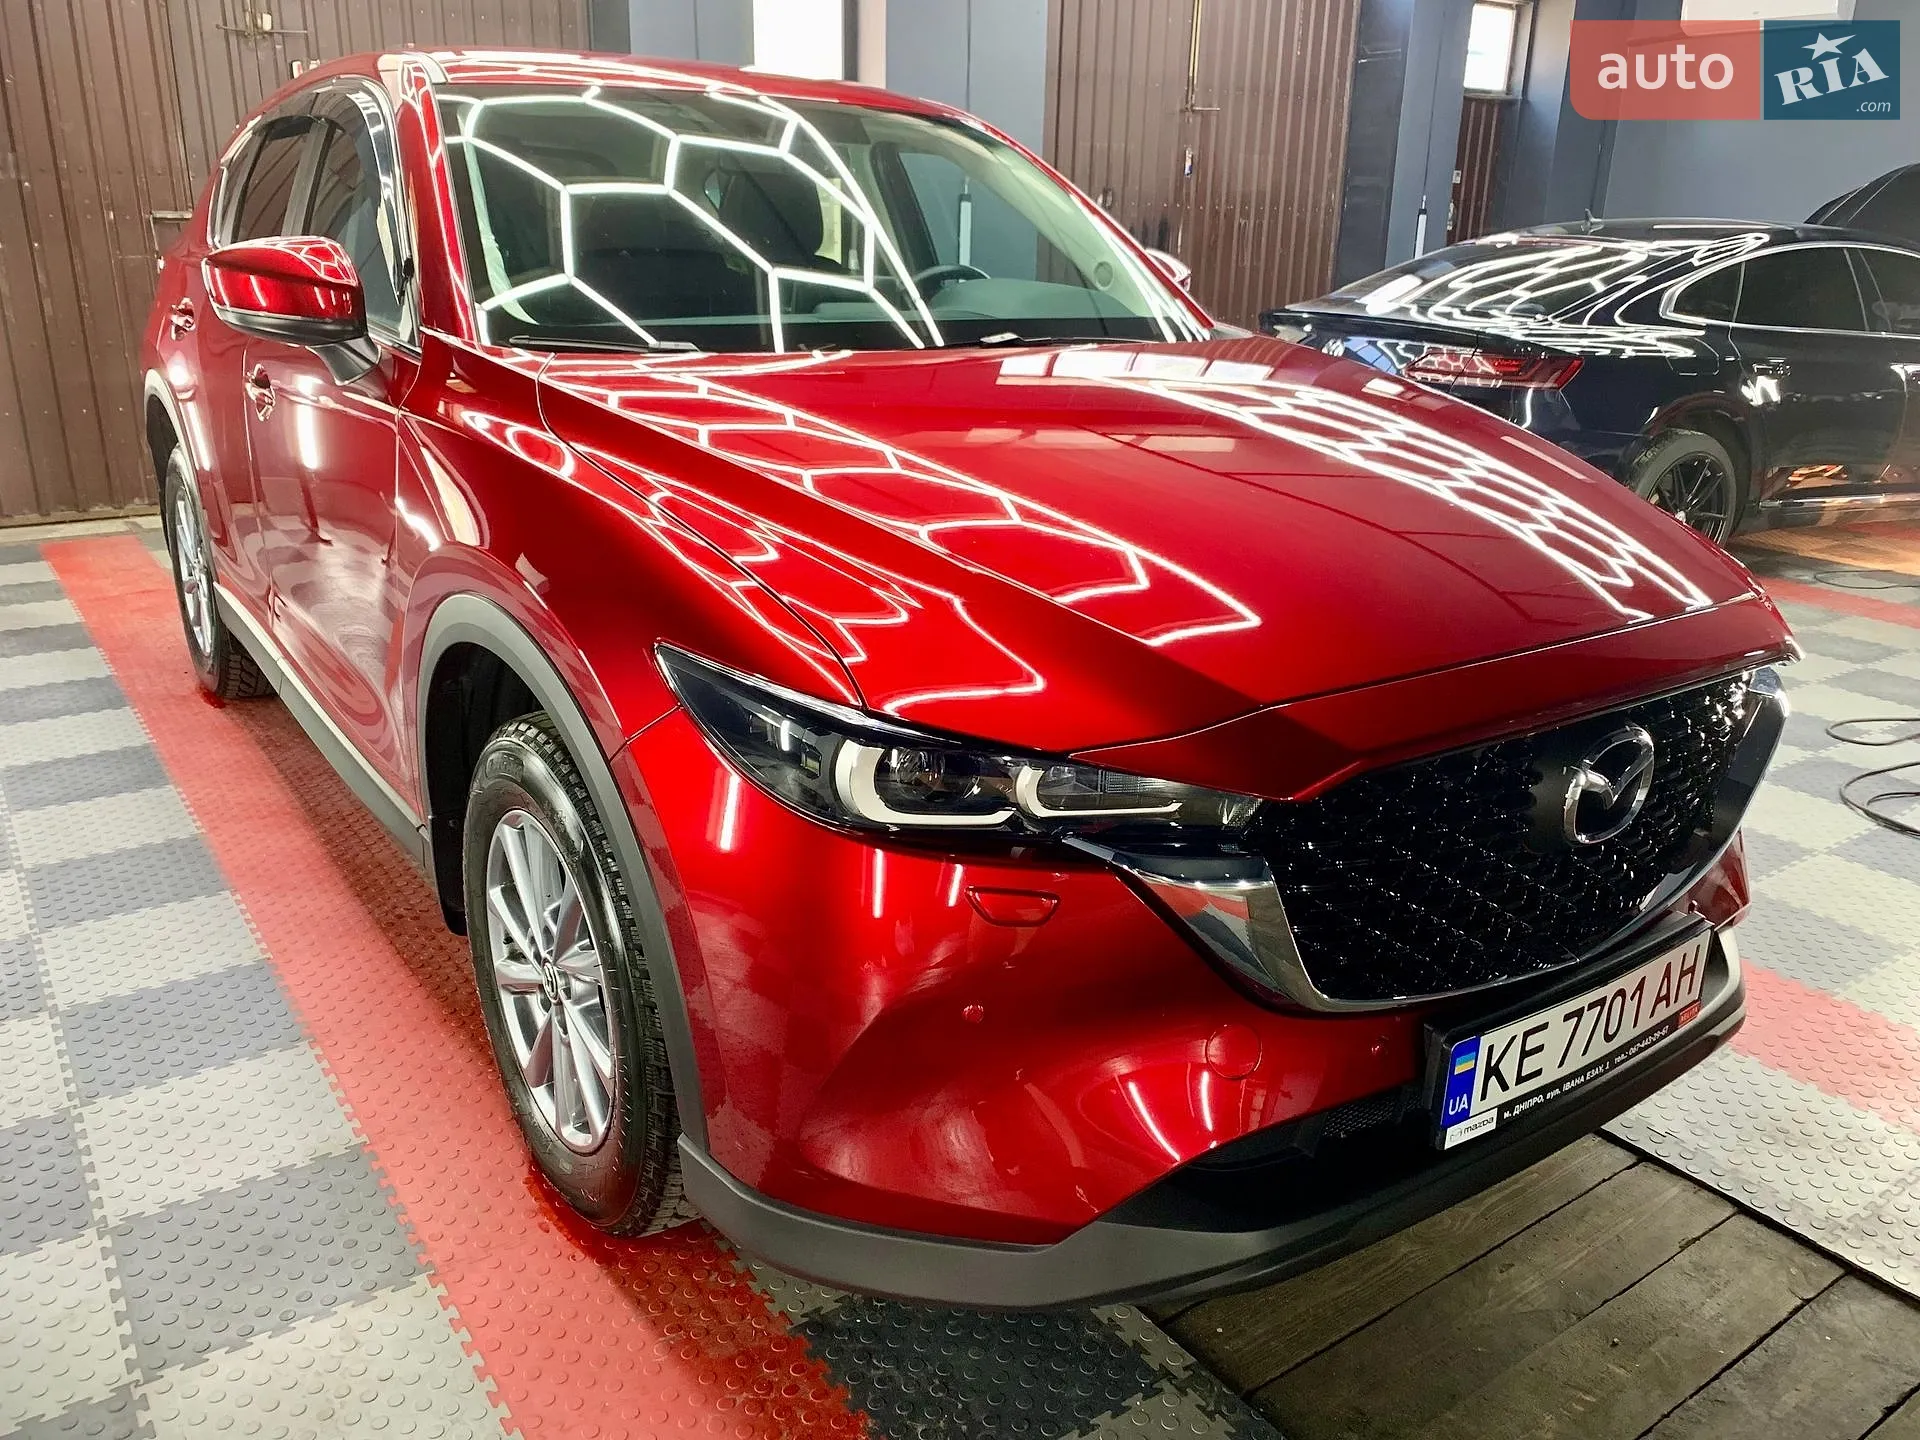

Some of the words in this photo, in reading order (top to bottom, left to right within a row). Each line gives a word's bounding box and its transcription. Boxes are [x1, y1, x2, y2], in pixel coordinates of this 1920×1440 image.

[1480, 1021, 1549, 1102] KE
[1558, 975, 1647, 1069] 7701
[1649, 944, 1701, 1019] AH
[1448, 1093, 1468, 1116] UA
[1513, 1094, 1545, 1117] ДНІПРО,
[1463, 1116, 1494, 1135] mazda
